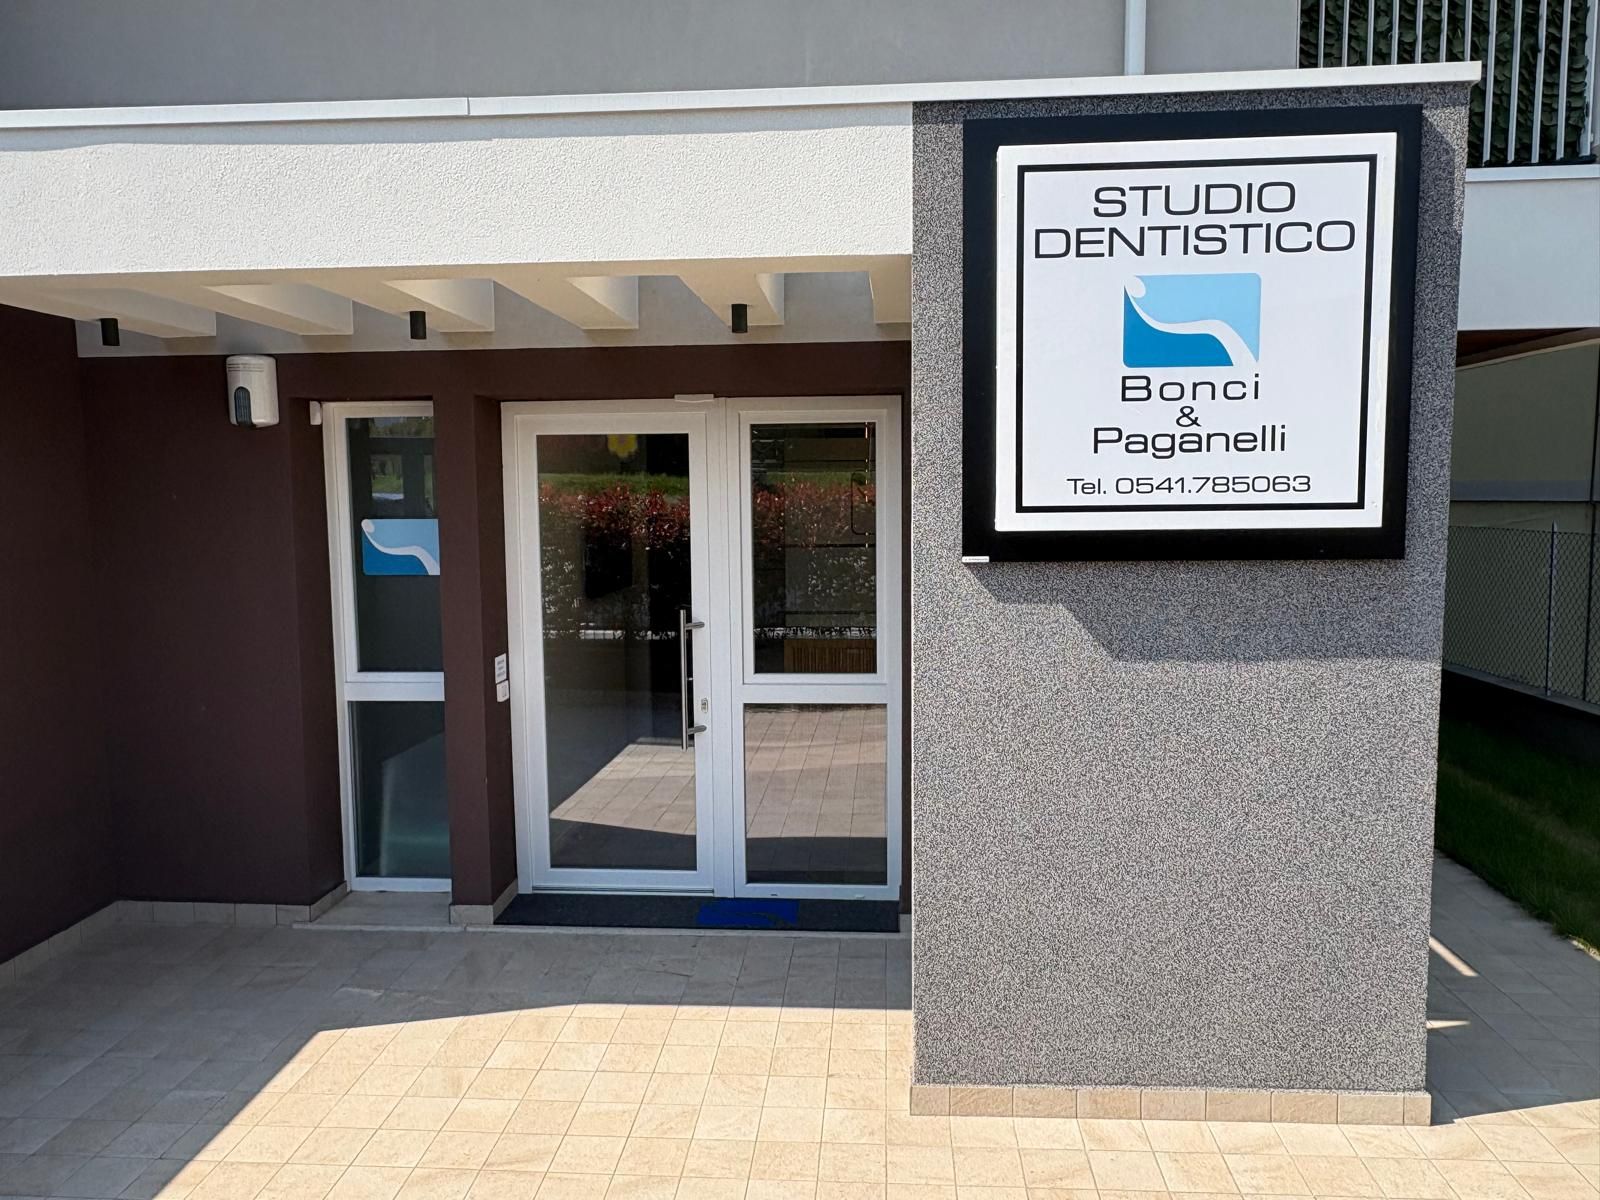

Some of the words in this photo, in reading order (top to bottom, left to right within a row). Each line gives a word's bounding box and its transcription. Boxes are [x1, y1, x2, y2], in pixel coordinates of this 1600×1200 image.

[1093, 182, 1296, 217] STUDIO
[1034, 221, 1356, 259] DENTISTICO
[1121, 373, 1259, 402] Bonci
[1175, 405, 1202, 428] &
[1093, 424, 1286, 460] Paganelli
[1066, 478, 1107, 495] Tel.
[1115, 475, 1311, 495] 0541.785063
